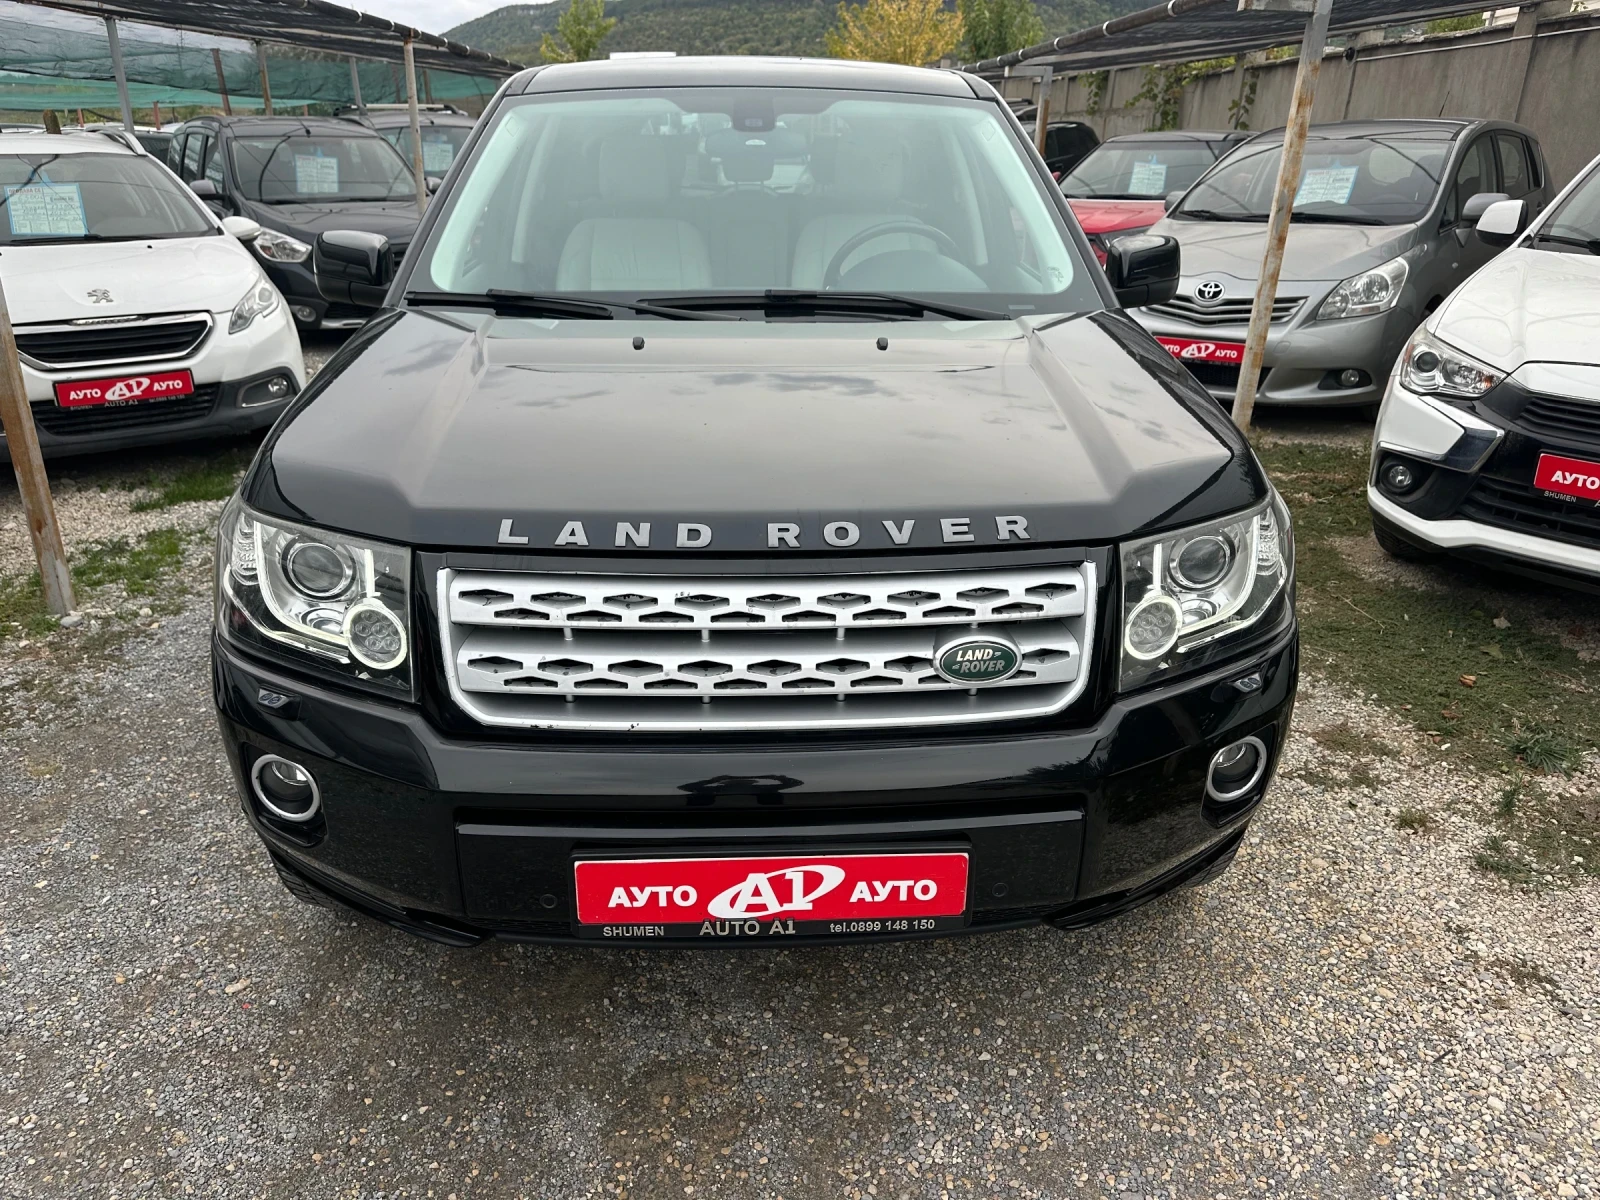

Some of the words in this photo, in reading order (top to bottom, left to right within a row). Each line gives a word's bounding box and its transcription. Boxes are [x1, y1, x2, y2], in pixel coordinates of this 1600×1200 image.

[1215, 349, 1238, 359] АУТО
[69, 388, 102, 401] АУТО
[153, 379, 183, 391] АУТО
[104, 400, 126, 408] AUTO
[1550, 470, 1600, 490] АУТО
[1544, 491, 1577, 503] SHUMEN
[497, 518, 714, 549] LAND
[766, 514, 1034, 549] ROVER
[955, 648, 995, 663] LAND
[959, 658, 1005, 674] ROVER
[608, 884, 698, 909] АУТО
[849, 879, 938, 904] АУТО
[602, 925, 665, 937] SHUMEN
[699, 918, 761, 937] AUTO
[768, 917, 796, 935] A1
[829, 921, 882, 933] tel.0899
[884, 920, 909, 931] 148
[911, 919, 936, 930] 150
